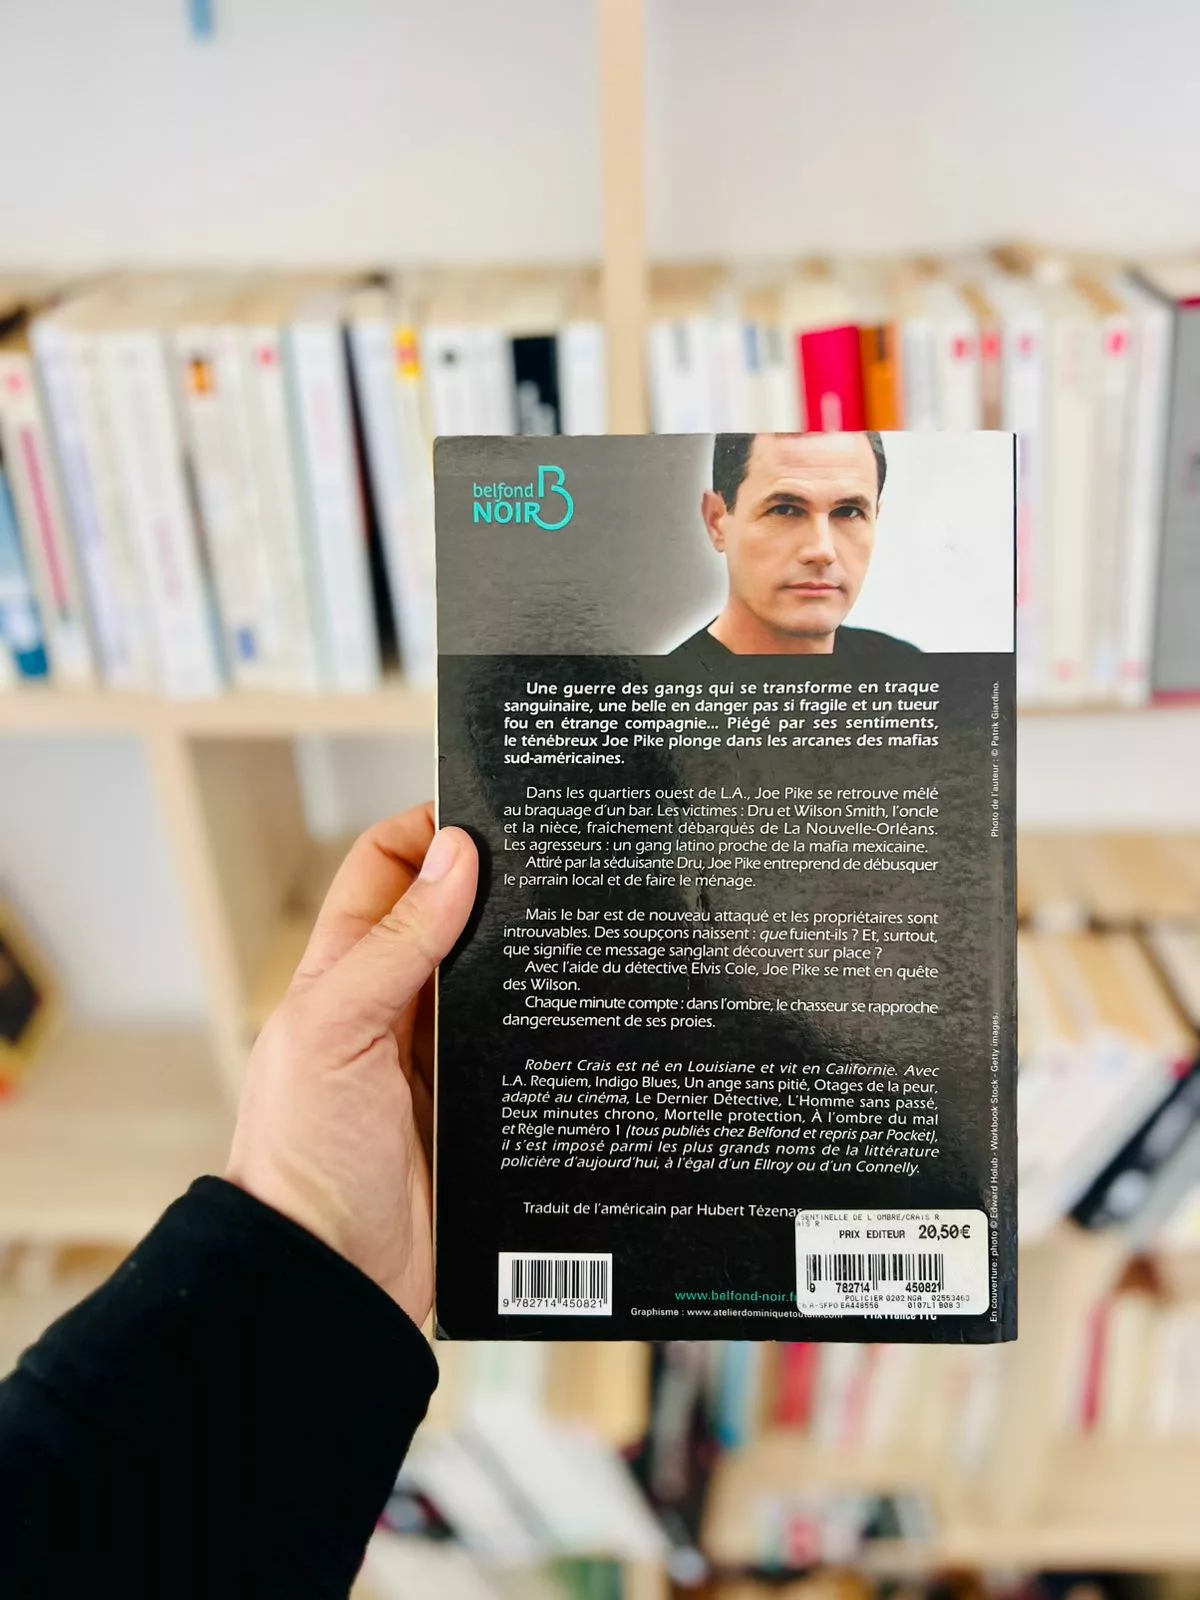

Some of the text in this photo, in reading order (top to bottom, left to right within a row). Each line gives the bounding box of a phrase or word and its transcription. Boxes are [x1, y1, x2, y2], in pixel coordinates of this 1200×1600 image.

[473, 482, 534, 502] belfond
[473, 501, 540, 524] NOIR
[527, 681, 939, 698] Une guerre des gangs qui se transforme en traque
[504, 699, 939, 715] sanguinaire, une belle en danger pas si fragile et un tueur
[991, 681, 999, 720] Giardino.
[504, 716, 938, 733] fou en étrange compagnie... Piégé par ses sentiments,
[504, 734, 939, 750] le ténébreux Joe Pike plonge dans les arcanes des mafias
[991, 722, 999, 746] Patrik
[504, 752, 624, 764] sud-américaines.
[991, 799, 999, 810] de
[504, 821, 938, 837] et la nièce, fraîchement débarqués de La Nouvelle-Orléans.
[991, 812, 999, 838] Photo
[525, 856, 939, 874] Attiré par la séduisante Dru, Joe Pike entreprend de débusquer
[526, 908, 939, 926] Mais le bar est de nouveau attaqué et les propriétaires sont
[525, 996, 577, 1012] Chaque
[580, 998, 626, 1009] minute
[628, 998, 678, 1013] compte
[686, 997, 719, 1010] dans
[777, 999, 788, 1011] le
[790, 999, 849, 1012] chasseur
[851, 1003, 866, 1012] se
[869, 1001, 938, 1016] rapproche
[503, 1014, 715, 1030] dangereusement de ses proies.
[525, 1059, 940, 1077] Robert Crais est né en Louisiane et vit en Californie. Avec
[990, 1048, 1000, 1072] Getty
[991, 1079, 999, 1104] Stock
[502, 1107, 537, 1119] Deux
[544, 1108, 599, 1119] minutes
[605, 1108, 658, 1121] chrono,
[665, 1109, 723, 1121] Mortelle
[728, 1111, 805, 1124] protection,
[811, 1109, 822, 1123] À
[888, 1113, 907, 1125] du
[913, 1114, 938, 1125] mal
[990, 1106, 999, 1151] Workbook
[990, 1158, 999, 1184] Holub
[523, 1201, 570, 1214] Traduit
[573, 1202, 591, 1214] de
[670, 1205, 693, 1219] par
[697, 1204, 745, 1217] Hubert
[990, 1186, 999, 1219] Edward
[801, 1213, 848, 1221] SENTINELLE
[853, 1213, 863, 1221] DE
[935, 1213, 940, 1221] R
[839, 1224, 971, 1241] PRIX EDITEUR 20,50€
[990, 1231, 999, 1257] photo
[809, 1282, 941, 1293] 9 782714 450821
[502, 1298, 603, 1309] 9 782714 450821
[886, 1294, 905, 1302] 0202
[907, 1294, 922, 1302] NGA
[630, 1307, 679, 1317] Graphisme
[990, 1311, 998, 1323] En
